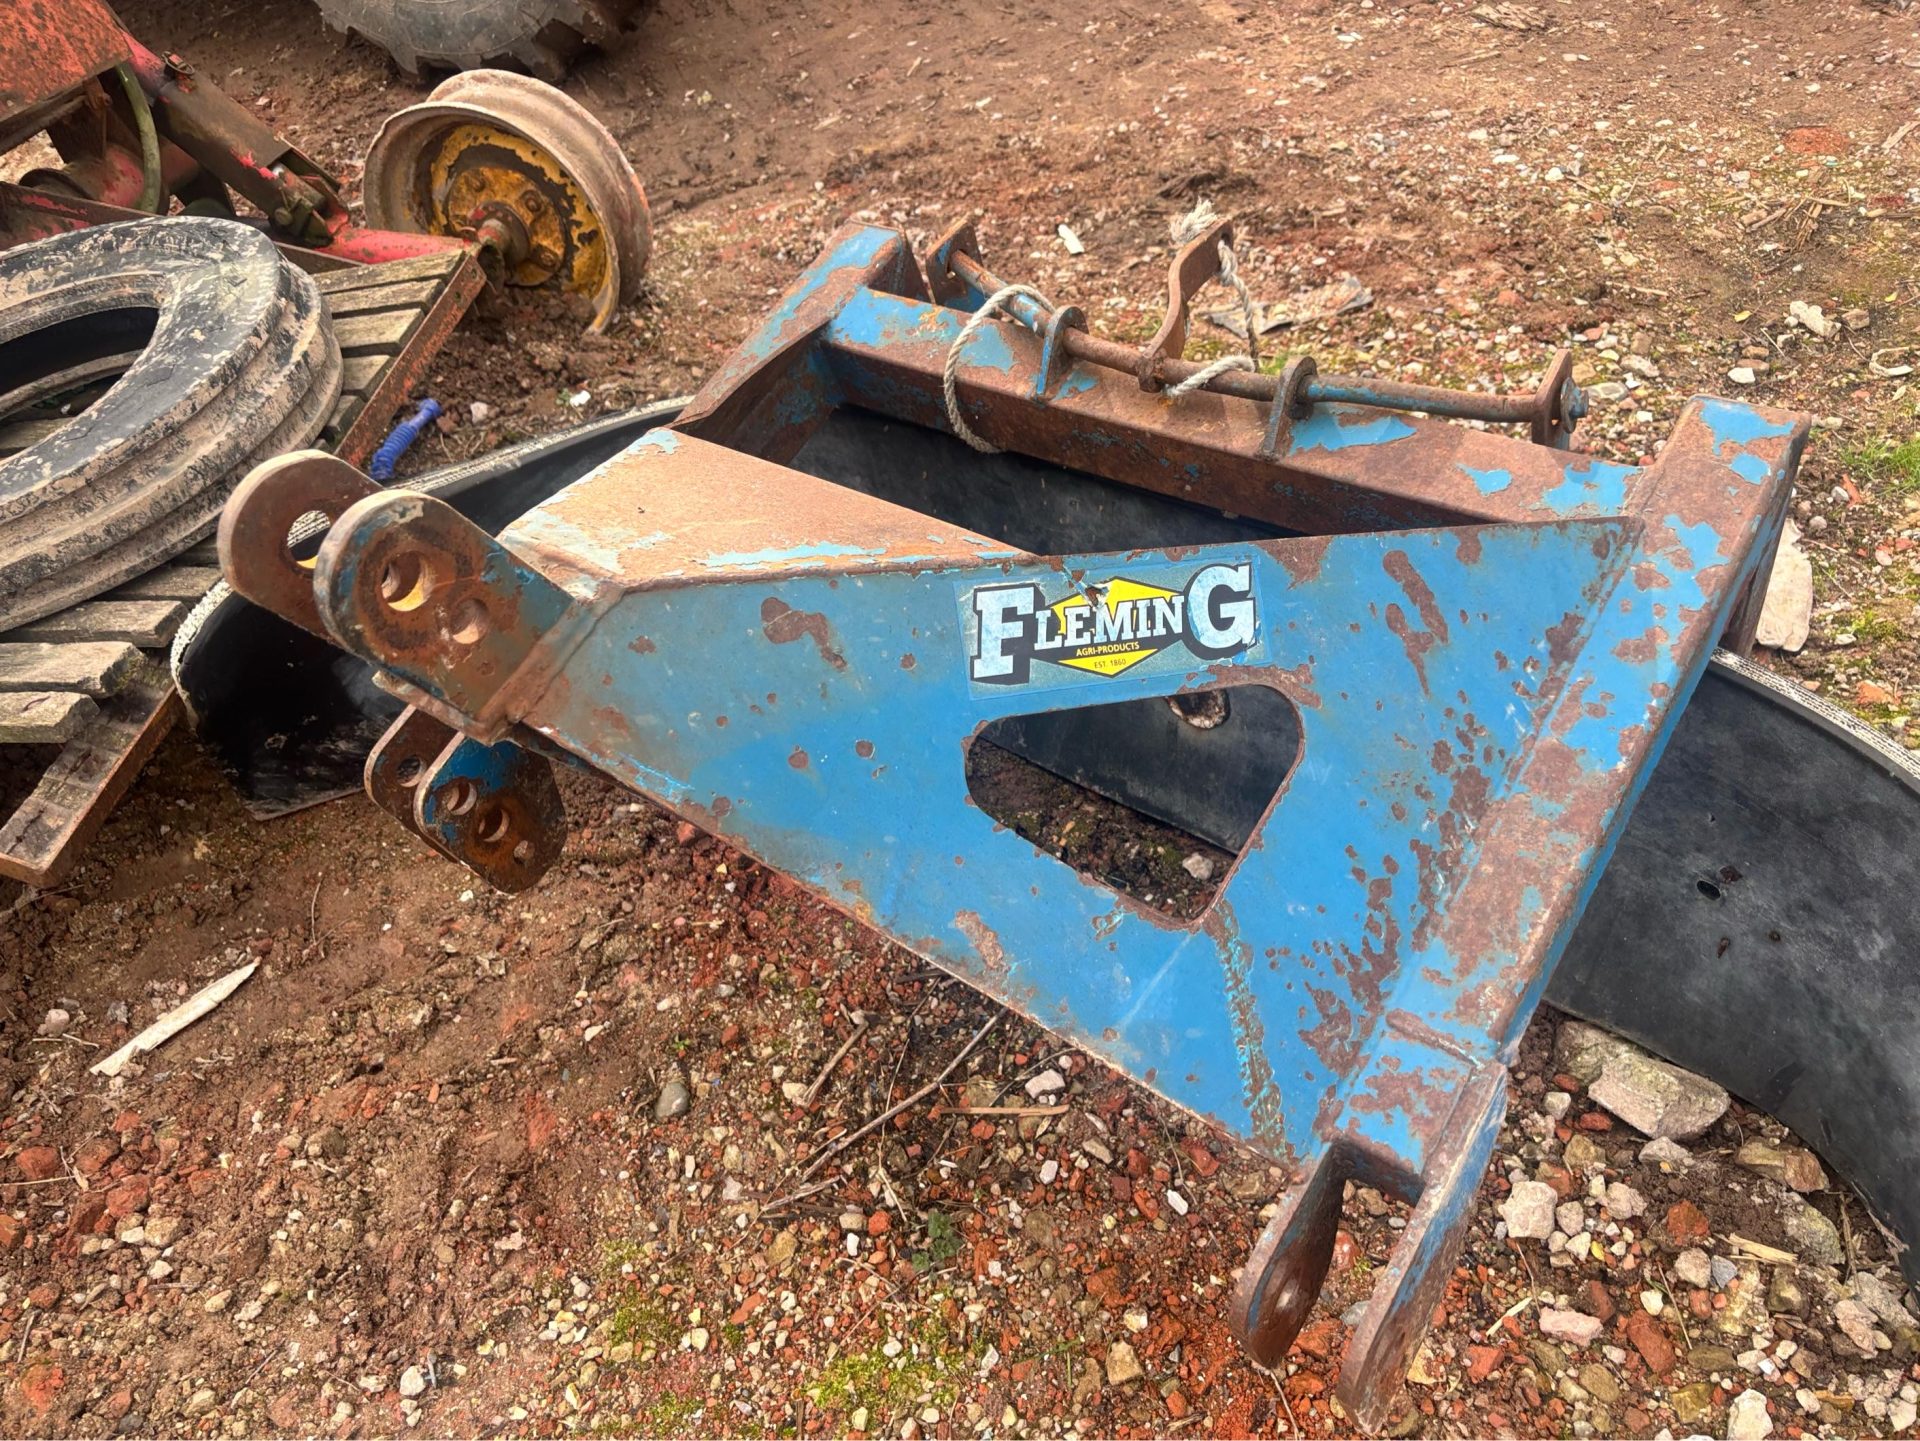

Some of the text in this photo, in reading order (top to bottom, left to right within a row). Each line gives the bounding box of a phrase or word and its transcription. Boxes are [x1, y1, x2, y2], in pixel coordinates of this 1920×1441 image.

[971, 564, 1256, 681] FLEMING
[1075, 641, 1140, 657] AGRI-PRODUCTS
[1110, 658, 1127, 668] 1860
